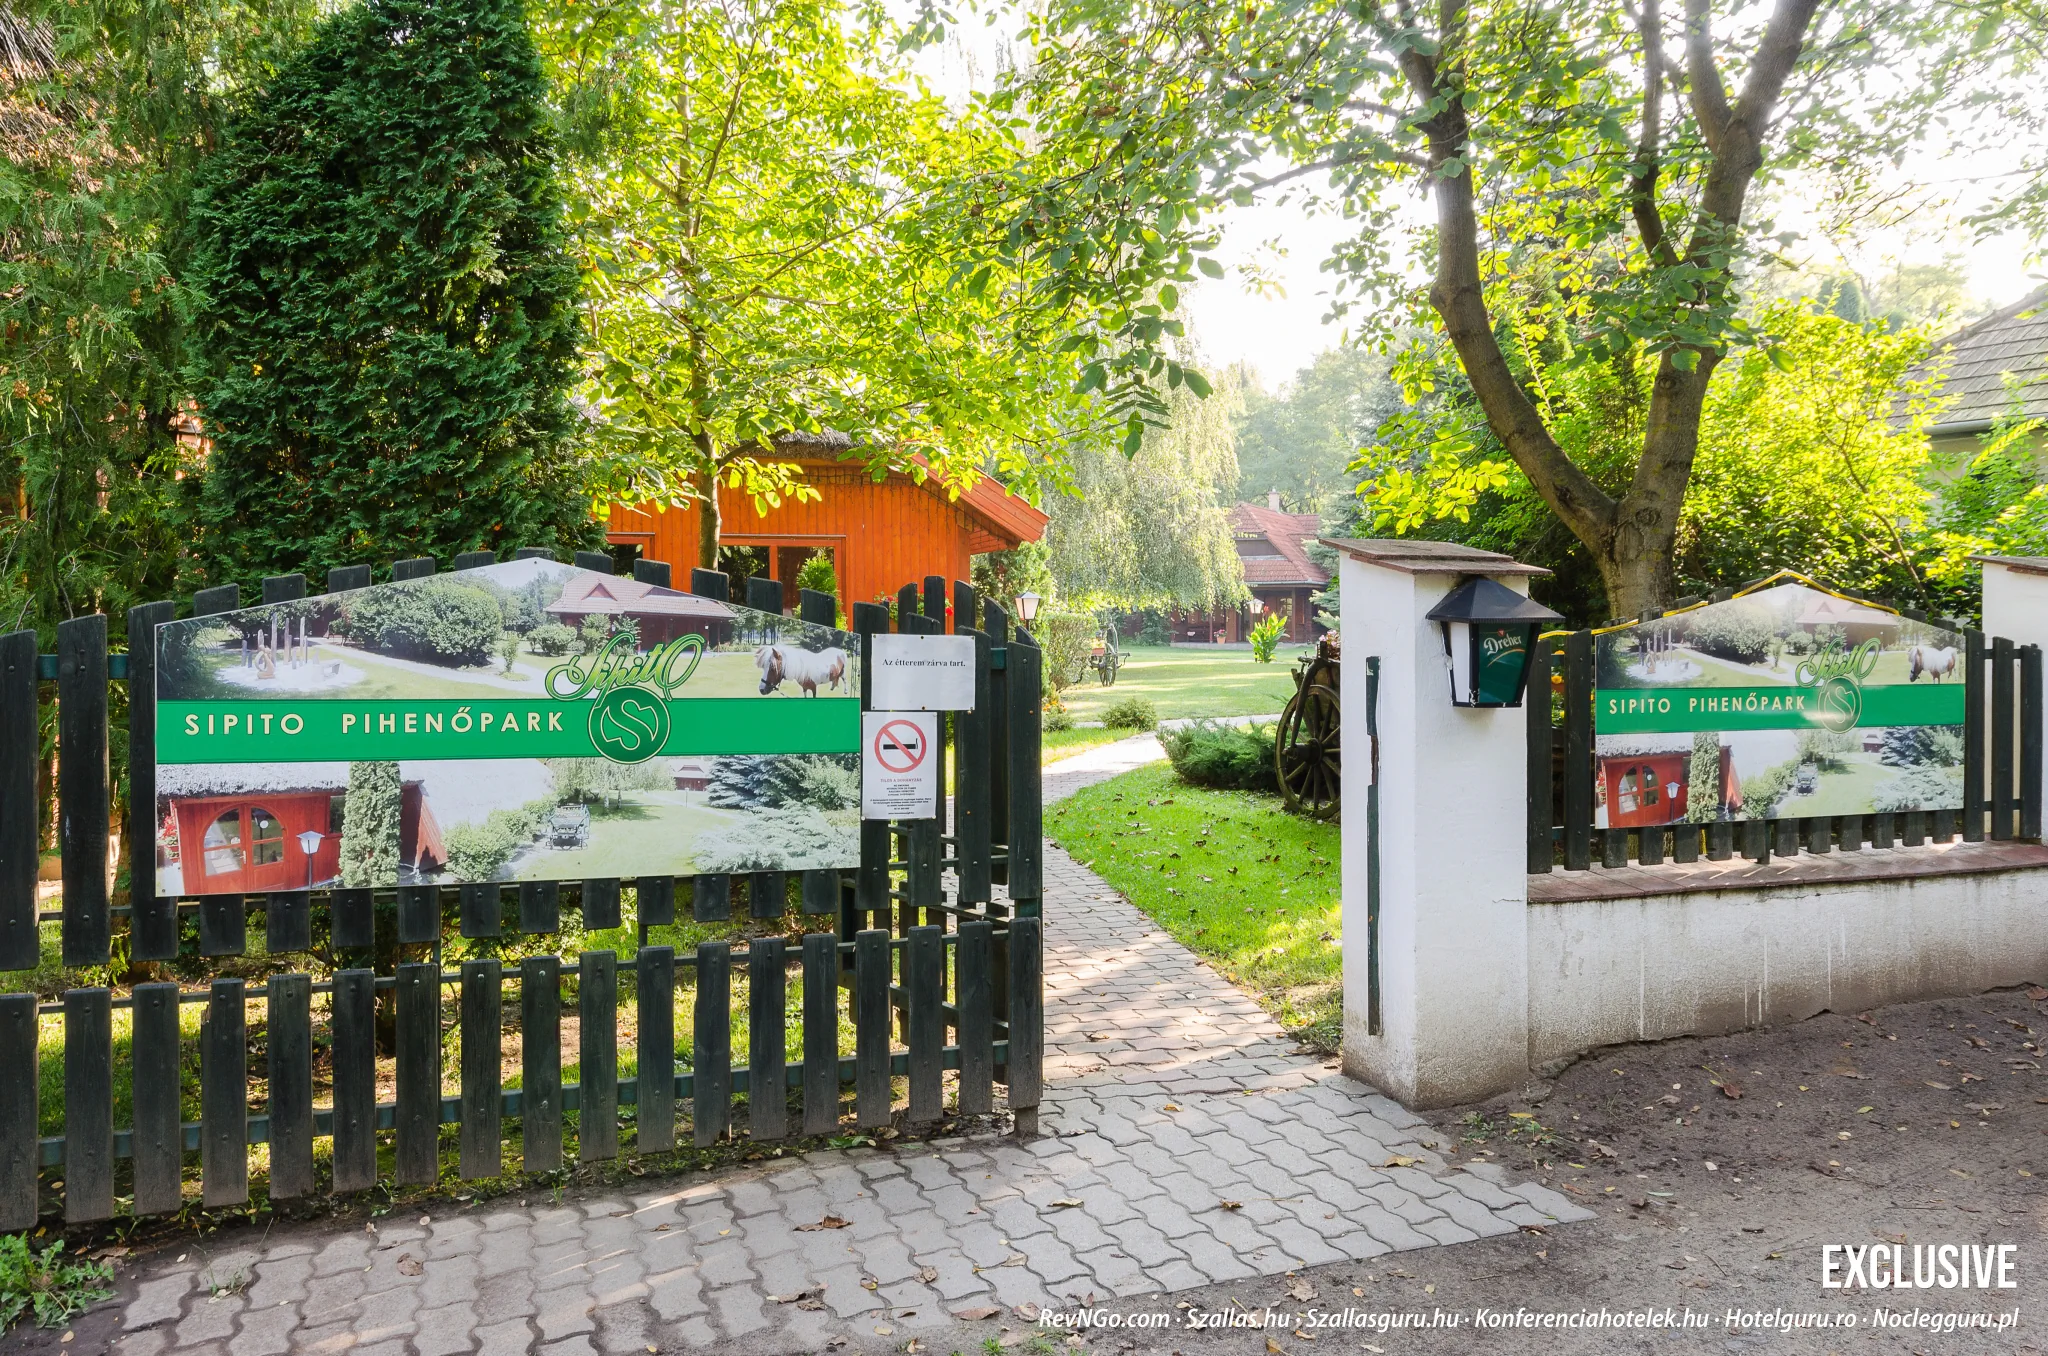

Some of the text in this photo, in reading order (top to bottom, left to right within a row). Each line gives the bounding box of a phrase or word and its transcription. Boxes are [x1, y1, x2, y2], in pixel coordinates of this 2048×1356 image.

[1483, 633, 1522, 656] Dreher
[882, 658, 966, 667] Az étterem zárva tart.
[1609, 692, 1806, 715] SIPITO PIHENŐPARK
[184, 706, 564, 736] SIPITO PIHENŐPARK
